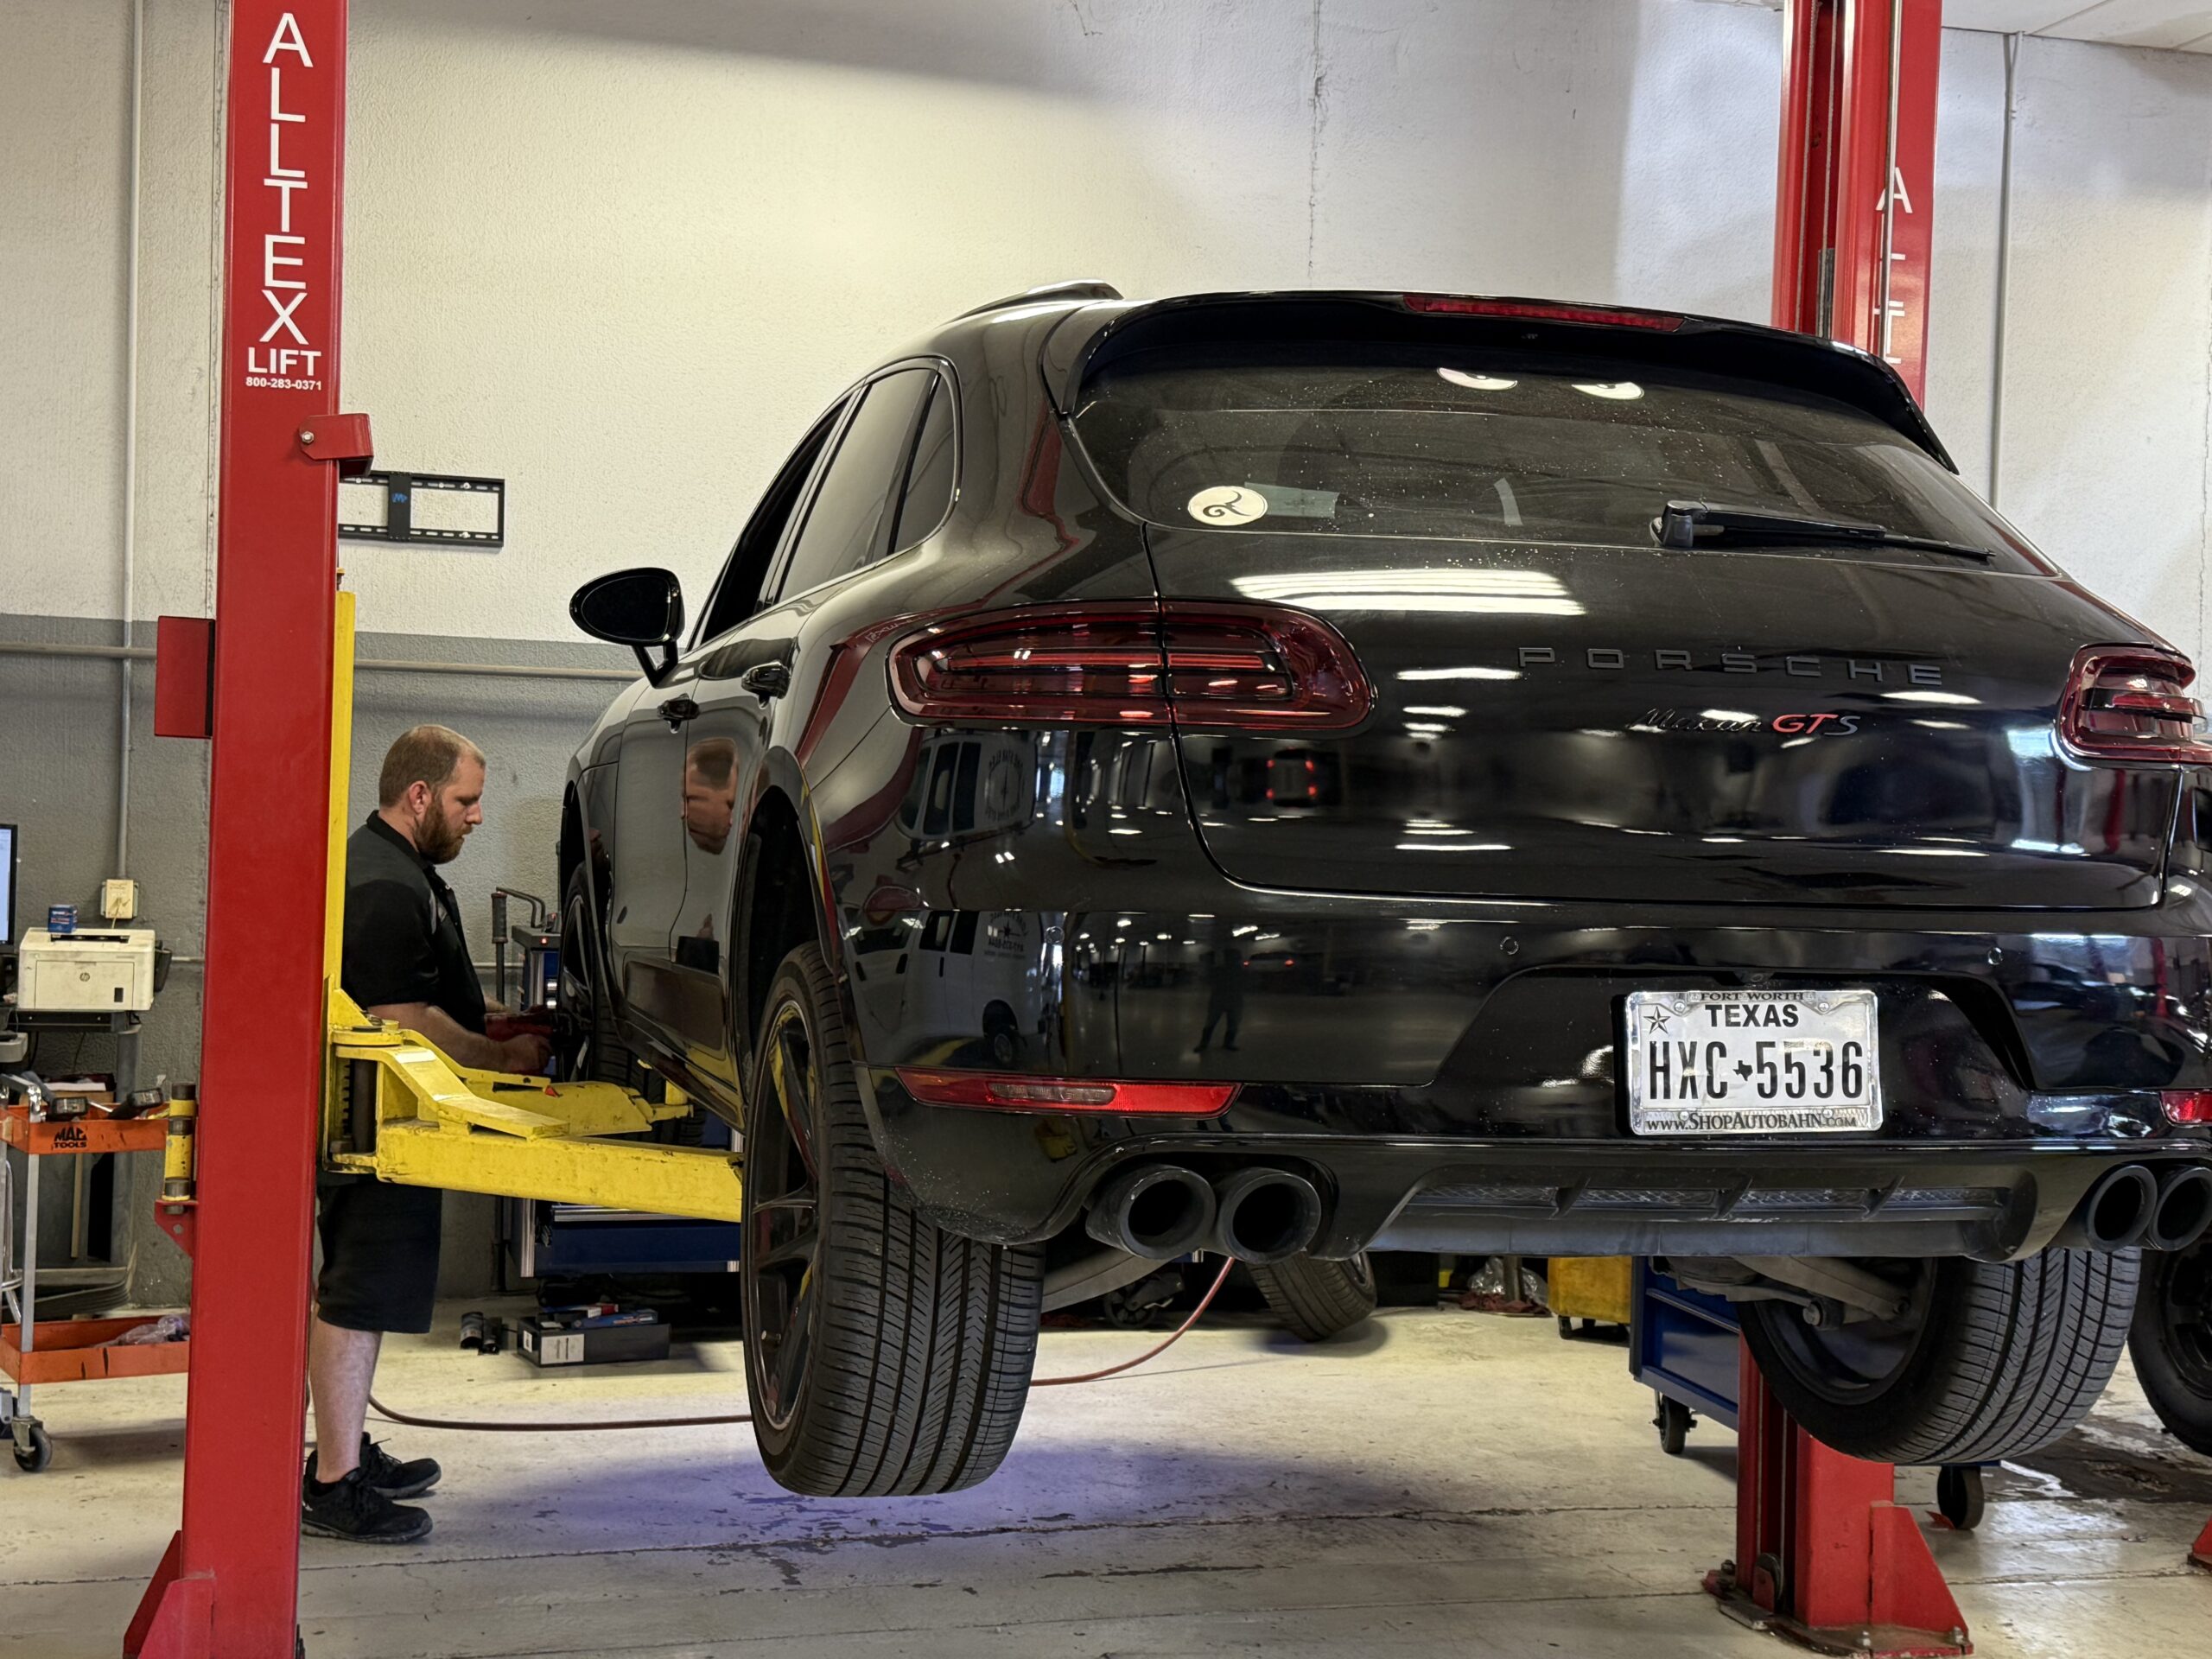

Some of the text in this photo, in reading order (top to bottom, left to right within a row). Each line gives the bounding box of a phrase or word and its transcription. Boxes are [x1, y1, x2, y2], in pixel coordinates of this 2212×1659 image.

[258, 12, 315, 346] ALLTEX
[247, 346, 322, 377] LIFT
[245, 377, 322, 391] 800-283-0371
[1517, 646, 1943, 686] PORSCHE
[1626, 708, 1861, 737] Macan GTS
[1700, 991, 1804, 1001] FORT WORTH
[1704, 1003, 1800, 1028] TEXAS
[1649, 1040, 1864, 1100] HXC 5536
[54, 1126, 87, 1141] MAC
